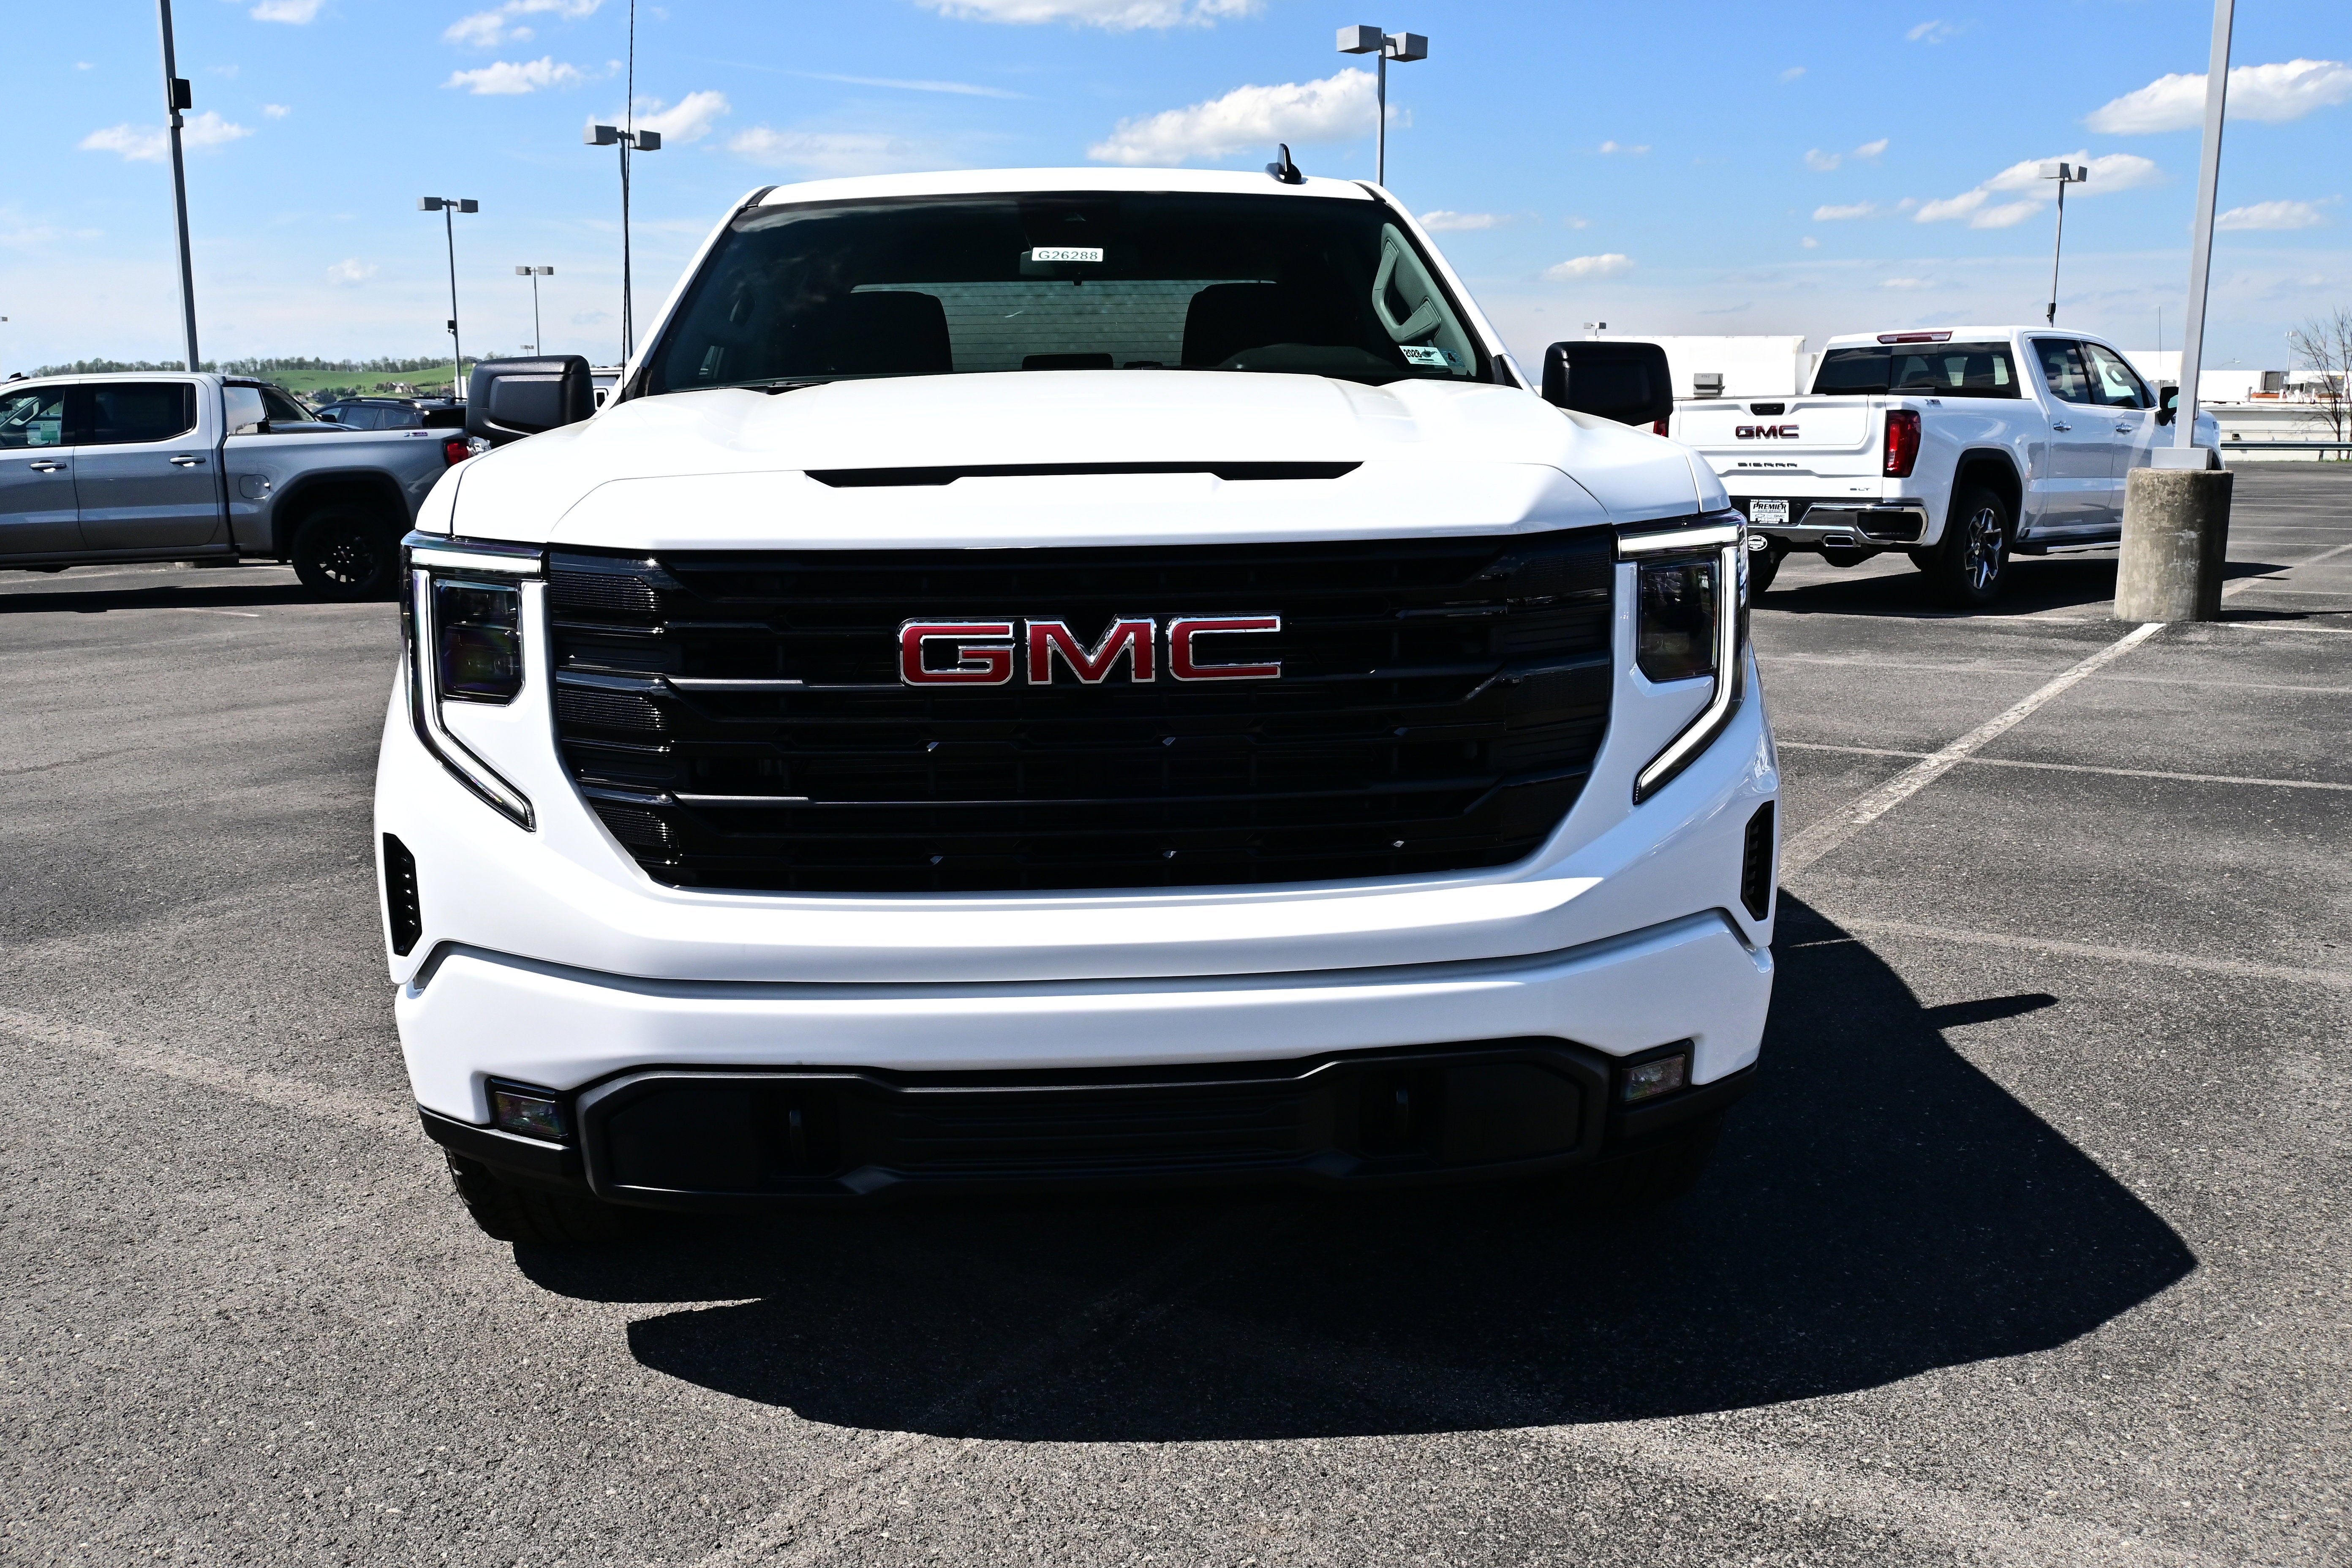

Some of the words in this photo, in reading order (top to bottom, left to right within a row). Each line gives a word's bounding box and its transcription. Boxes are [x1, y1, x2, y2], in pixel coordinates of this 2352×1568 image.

[1039, 251, 1097, 259] G26288
[1403, 349, 1422, 358] 2028
[1448, 352, 1456, 362] 4
[1736, 424, 1799, 440] GMC
[1753, 503, 1786, 512] PREMIER
[898, 616, 1280, 685] GMC
